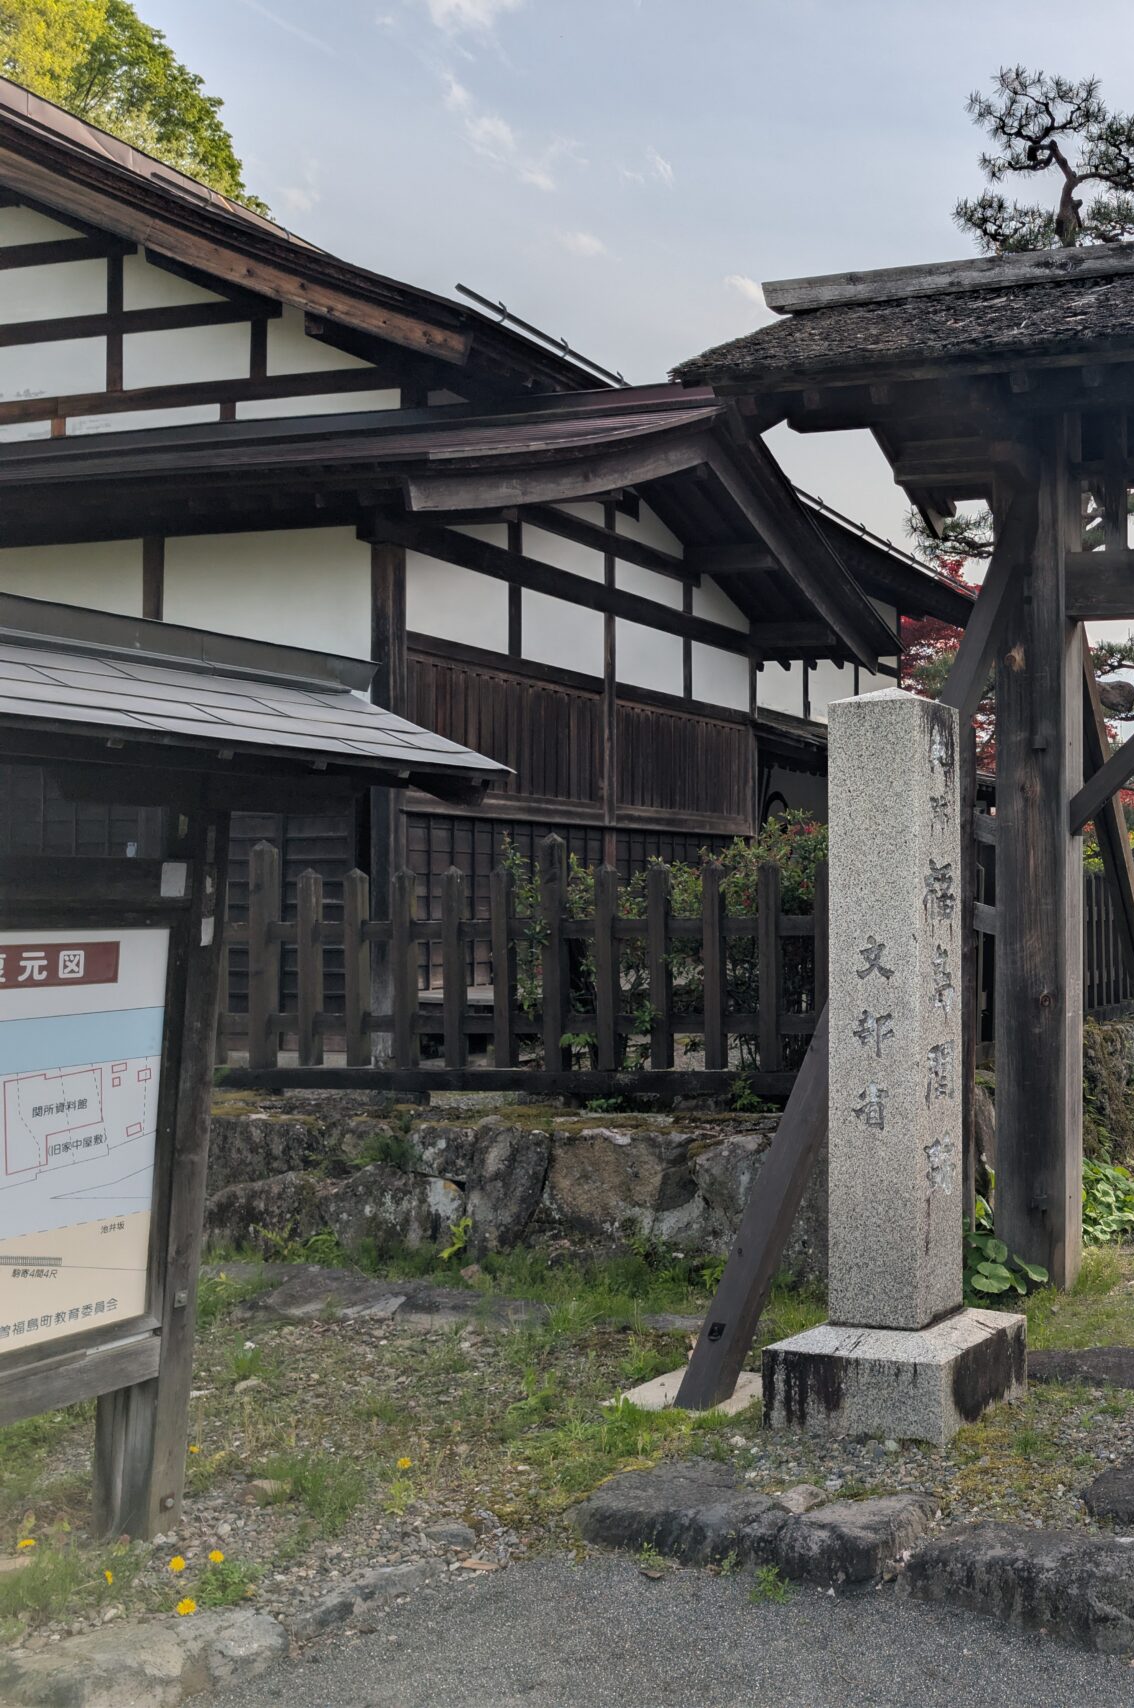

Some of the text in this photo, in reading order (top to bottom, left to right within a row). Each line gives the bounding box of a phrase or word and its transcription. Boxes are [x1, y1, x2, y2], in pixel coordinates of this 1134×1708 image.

[0, 950, 84, 982] 元図
[32, 1099, 88, 1118] 関所資料館
